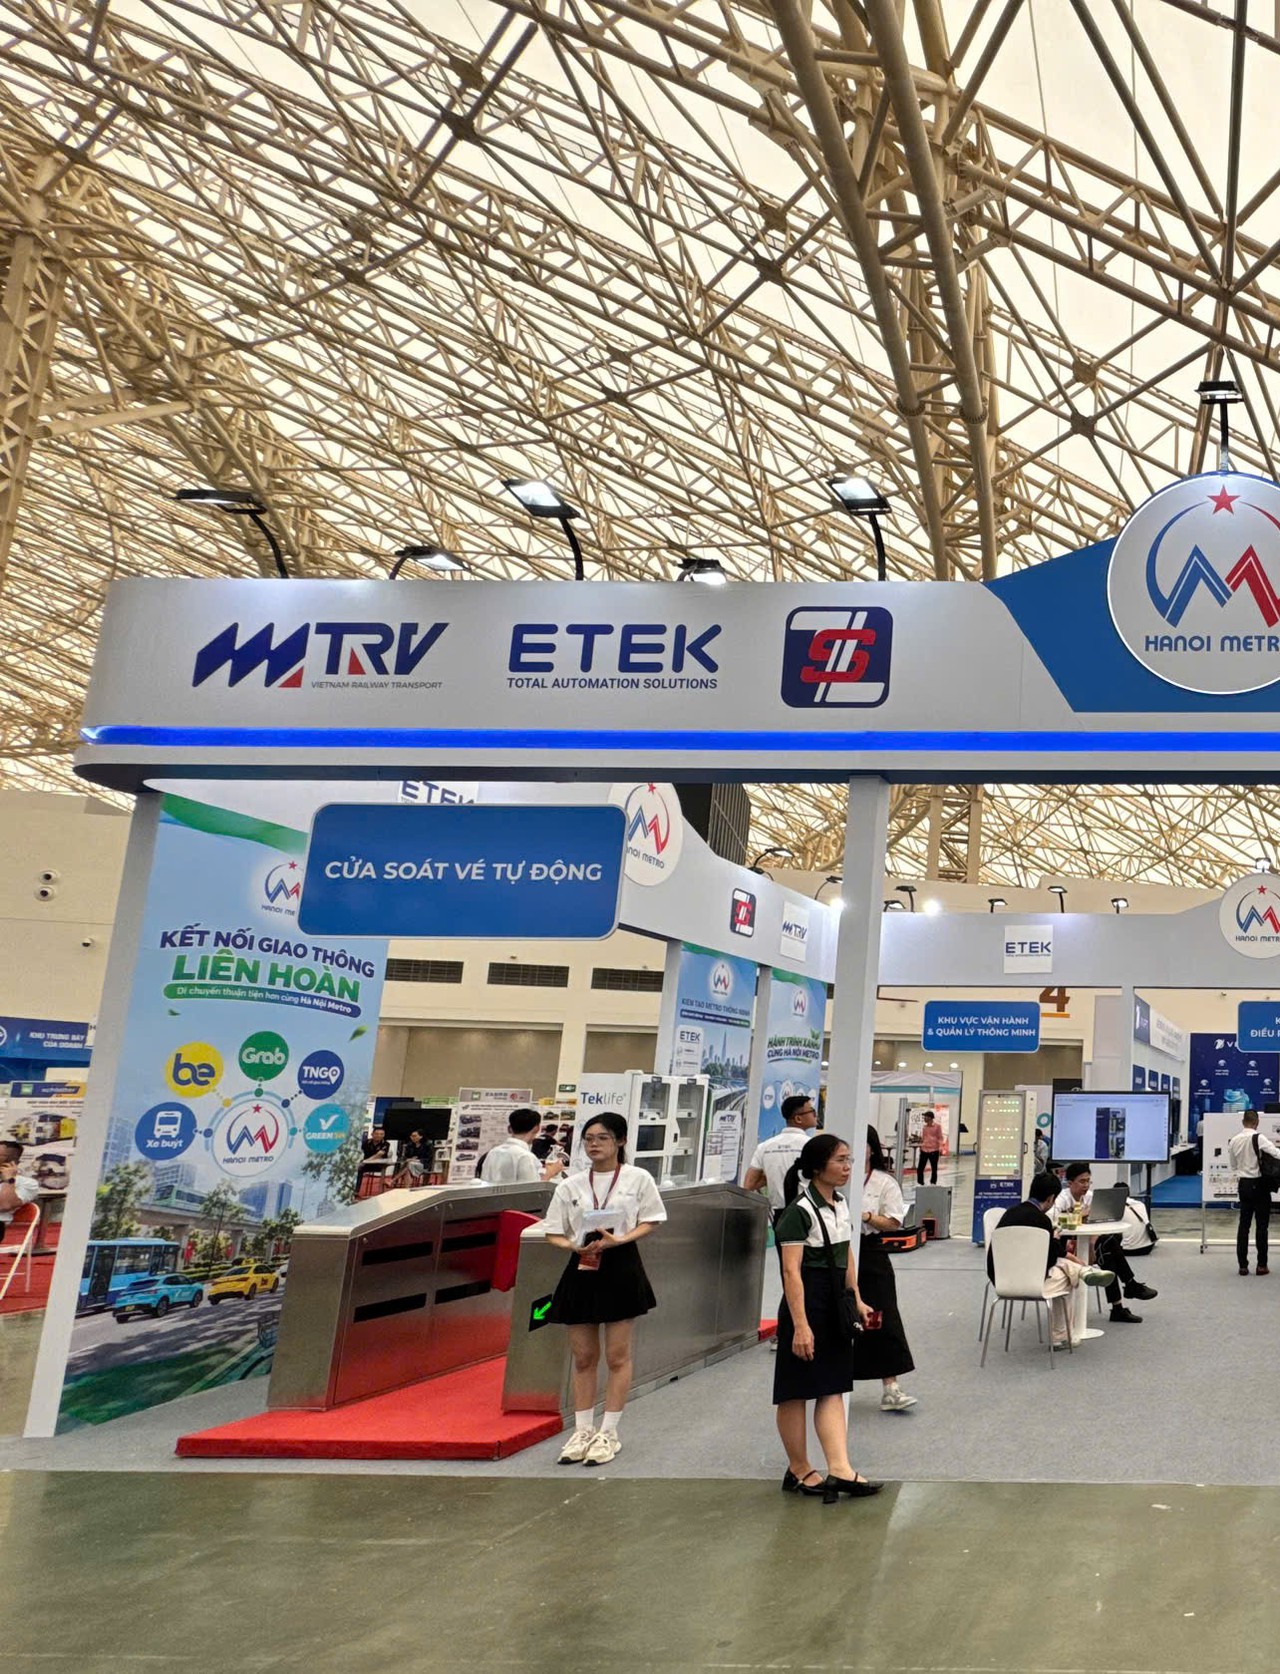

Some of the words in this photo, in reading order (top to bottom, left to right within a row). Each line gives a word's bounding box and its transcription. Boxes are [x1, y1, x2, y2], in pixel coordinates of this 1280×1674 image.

[508, 623, 722, 674] ETEK
[1145, 635, 1211, 652] HANOI
[311, 681, 350, 689] VIETNAM
[351, 681, 390, 689] RAILWAY
[391, 681, 443, 690] TRANSPORT
[506, 678, 548, 690] TOTAL
[552, 678, 640, 690] AUTOMATION
[643, 678, 718, 690] SOLUTIONS
[642, 853, 665, 869] METRO
[325, 856, 377, 881] CỬA
[383, 857, 449, 881] SOÁT
[454, 857, 487, 881] VÉ
[492, 859, 526, 885] TỰ
[529, 858, 603, 886] ĐỘNG
[261, 905, 283, 913] HANOI
[160, 923, 210, 949] KẾT
[213, 928, 254, 951] NỐI
[258, 937, 308, 959] GIAO
[312, 947, 375, 978] THÔNG
[1005, 942, 1051, 954] ETEK
[172, 949, 260, 983] LIÊN
[267, 963, 361, 1003] HOÀN
[300, 996, 311, 1005] Hà
[313, 998, 326, 1011] Nội
[328, 1001, 352, 1013] Metro
[1039, 987, 1071, 1012] 4
[938, 1016, 958, 1024] KHU
[959, 1016, 979, 1026] VỰC
[981, 1015, 1000, 1027] VẬN
[1002, 1015, 1029, 1025] HÀNH
[680, 1031, 701, 1041] ETEK
[936, 1026, 962, 1037] QUẢN
[964, 1026, 976, 1036] LÝ
[977, 1026, 1009, 1037] THÔNG
[1011, 1029, 1036, 1037] MINH
[1250, 1026, 1275, 1038] ĐIỀU
[241, 1047, 286, 1065] Grab
[172, 1053, 215, 1086] be
[302, 1066, 341, 1083] TNGO
[146, 1139, 158, 1148] Xe
[160, 1138, 184, 1150] buýt
[223, 1156, 246, 1164] HANOI
[248, 1155, 274, 1164] METRO
